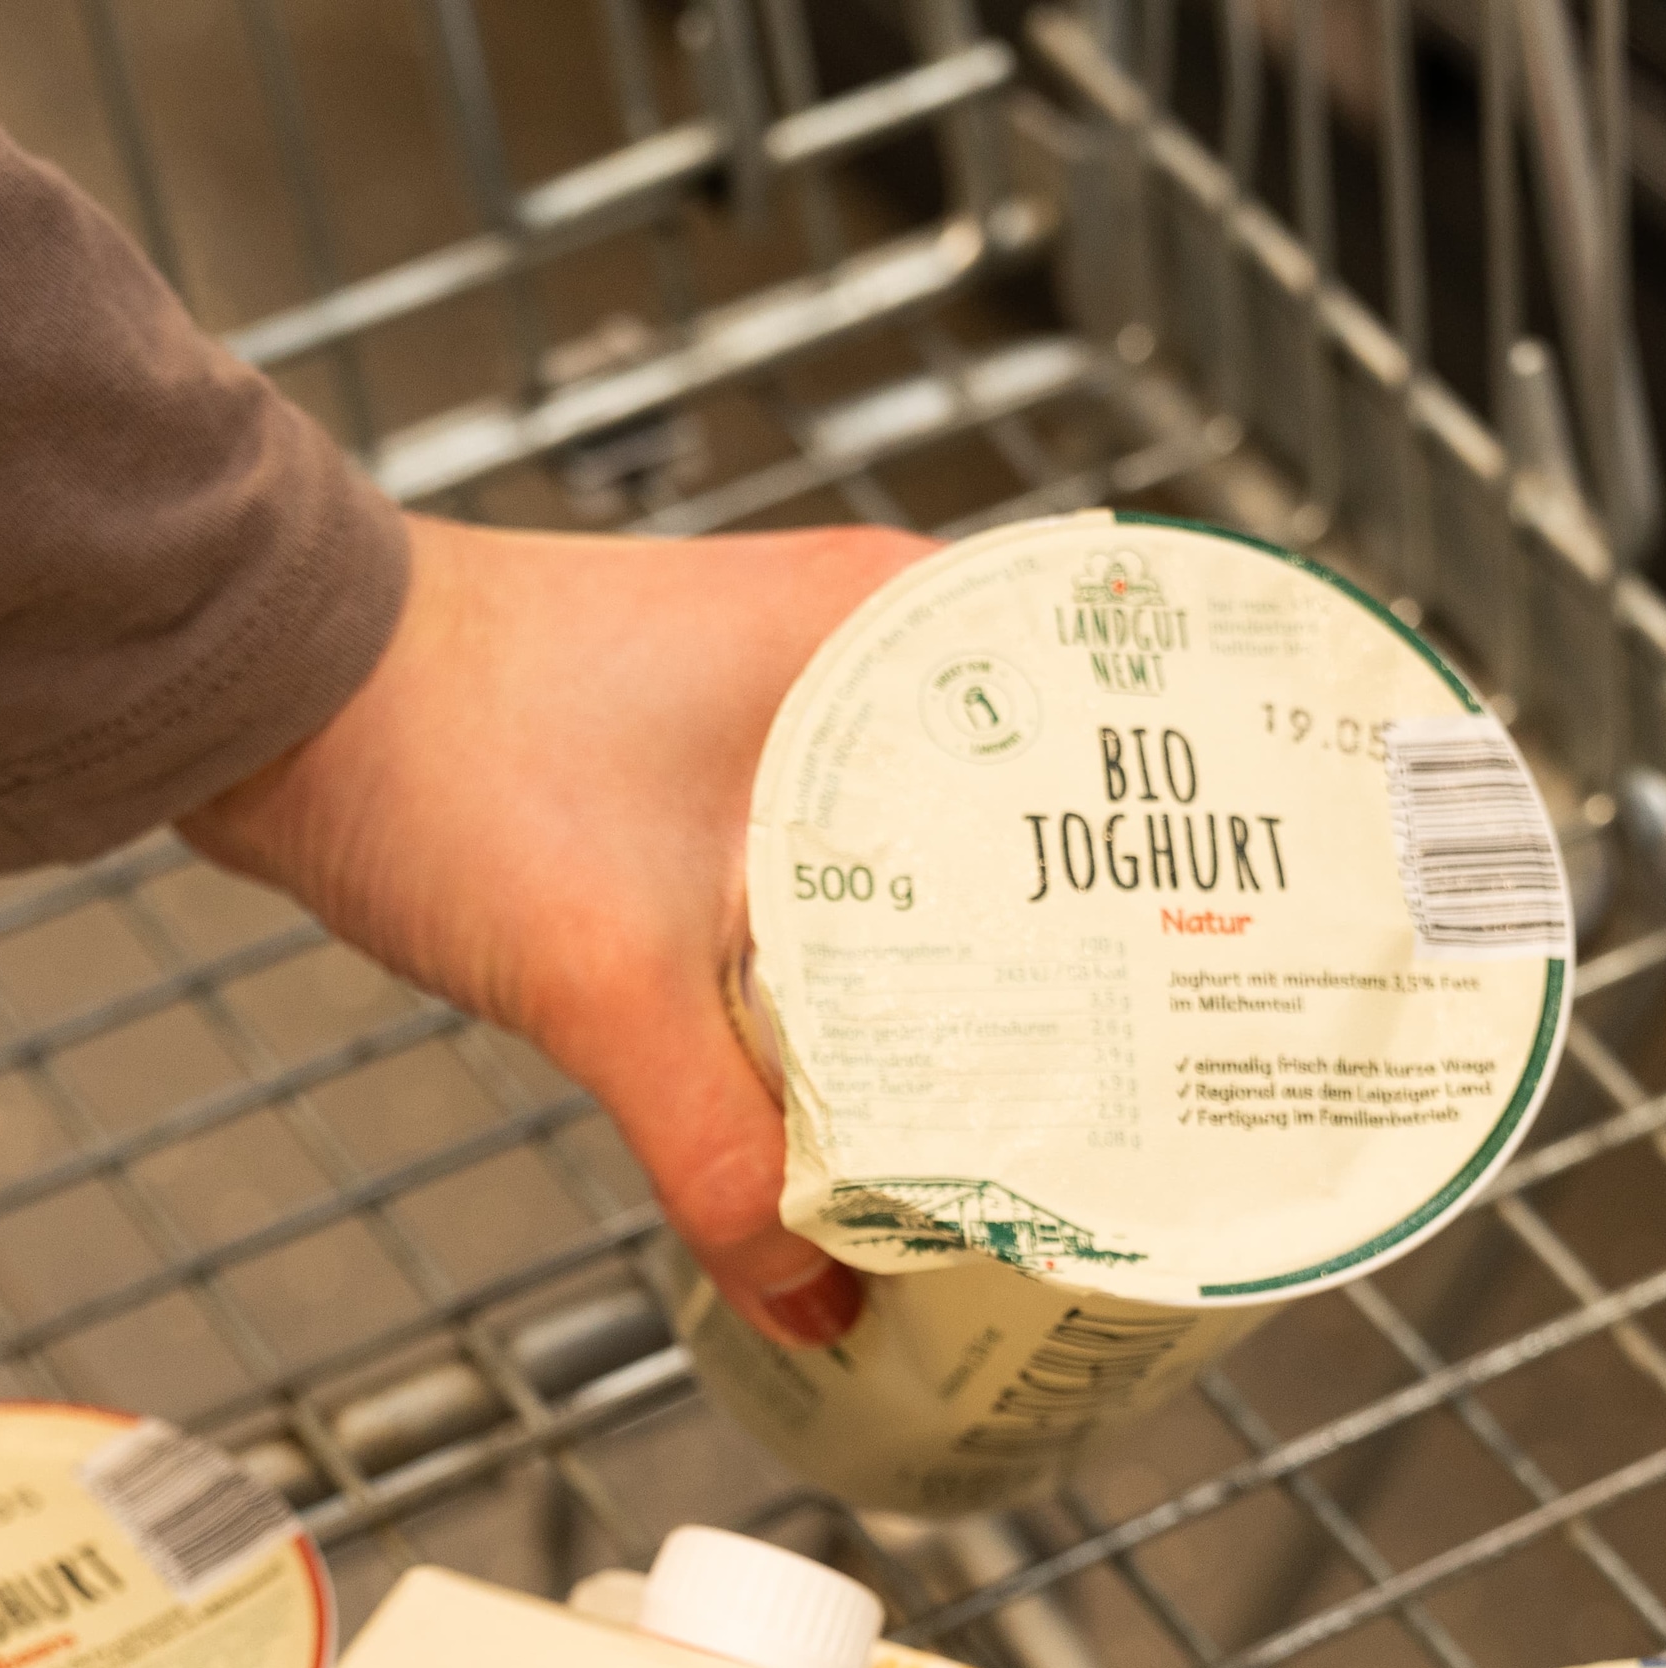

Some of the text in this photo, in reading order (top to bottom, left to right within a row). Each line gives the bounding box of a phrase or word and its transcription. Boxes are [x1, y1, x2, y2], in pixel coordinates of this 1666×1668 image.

[1056, 604, 1188, 651] LANDGUT
[1092, 653, 1161, 689] NEMT
[1100, 727, 1198, 804] BIO
[1024, 812, 1286, 903] JOGHURT
[794, 862, 915, 911] 500 g
[1161, 909, 1253, 935] Natur
